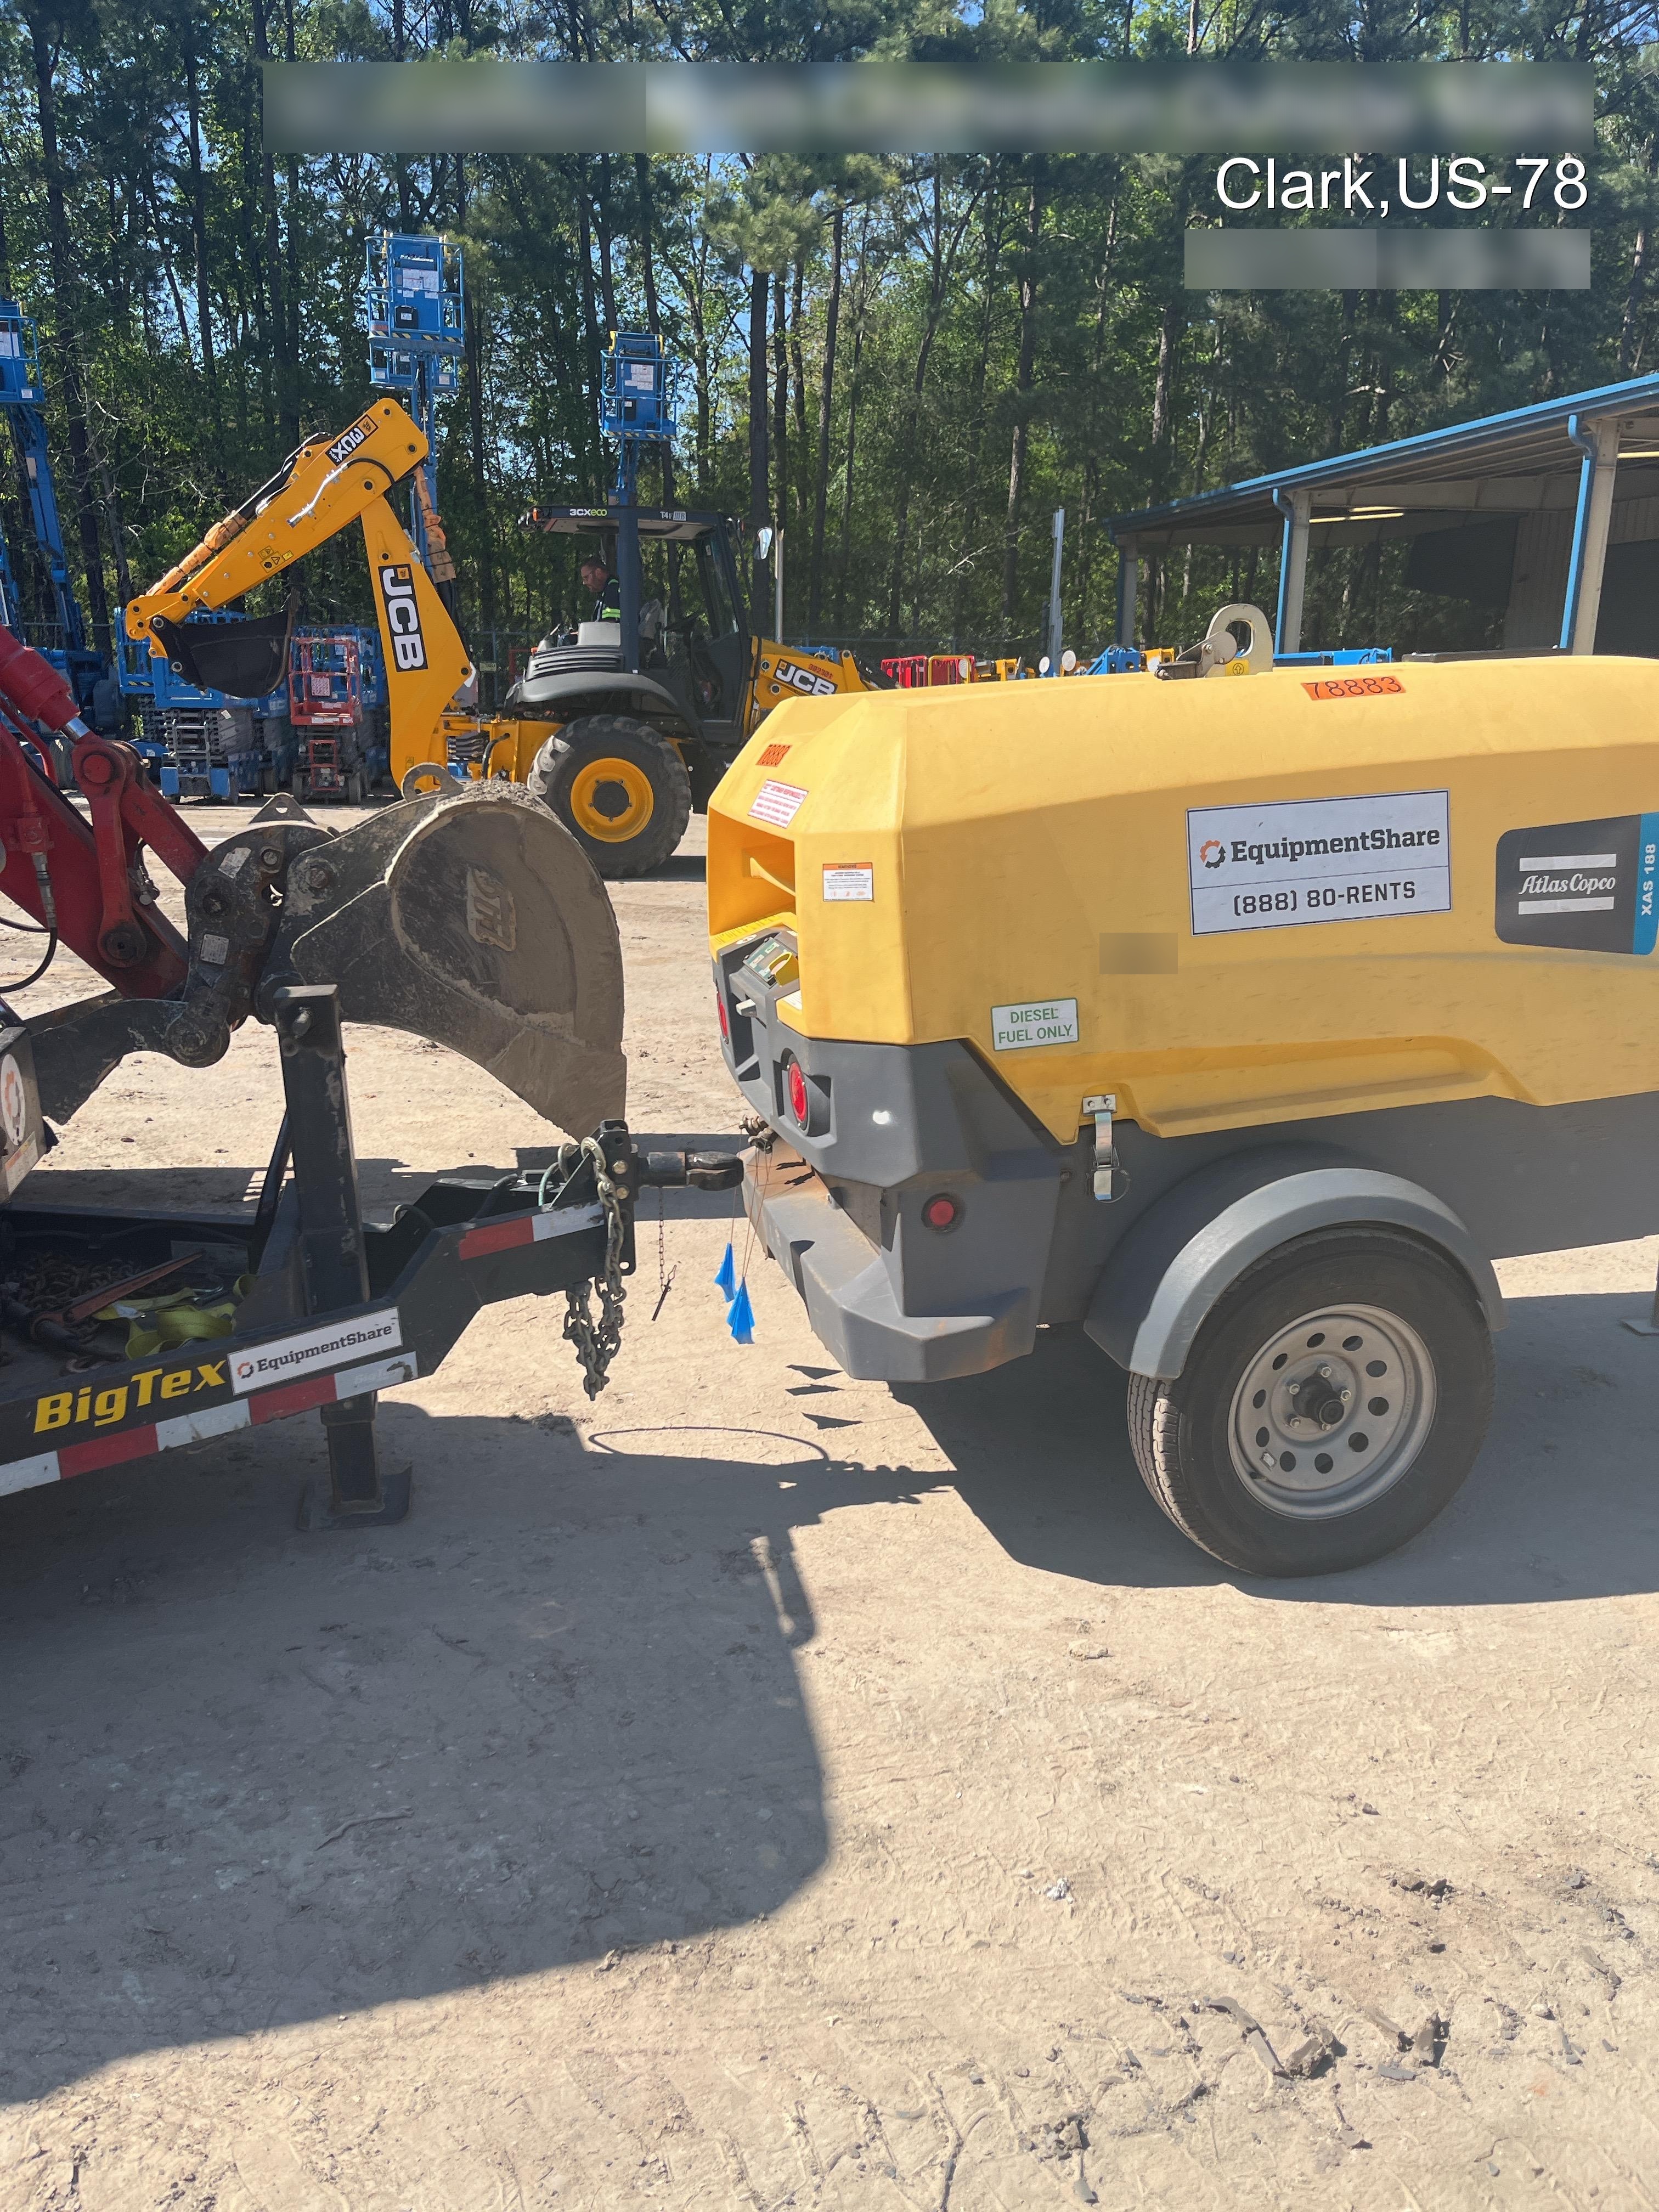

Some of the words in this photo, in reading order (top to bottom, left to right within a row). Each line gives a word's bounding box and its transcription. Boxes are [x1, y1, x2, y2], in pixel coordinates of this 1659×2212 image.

[330, 427, 365, 461] 3CX
[382, 568, 424, 670] JCB
[775, 665, 835, 695] JCB
[1305, 676, 1402, 698] 78883
[1231, 828, 1441, 865] EquipmentShare
[1644, 843, 1656, 875] 188
[1233, 890, 1297, 917] (888)
[1307, 880, 1416, 909] 80-RENTS
[1640, 879, 1654, 916] XAS
[1010, 1007, 1059, 1024] DIESEL
[998, 1029, 1033, 1044] FUEL
[1036, 1024, 1073, 1040] ONLY
[256, 1324, 392, 1373] EquipmentShare
[33, 1359, 227, 1434] BigTex
